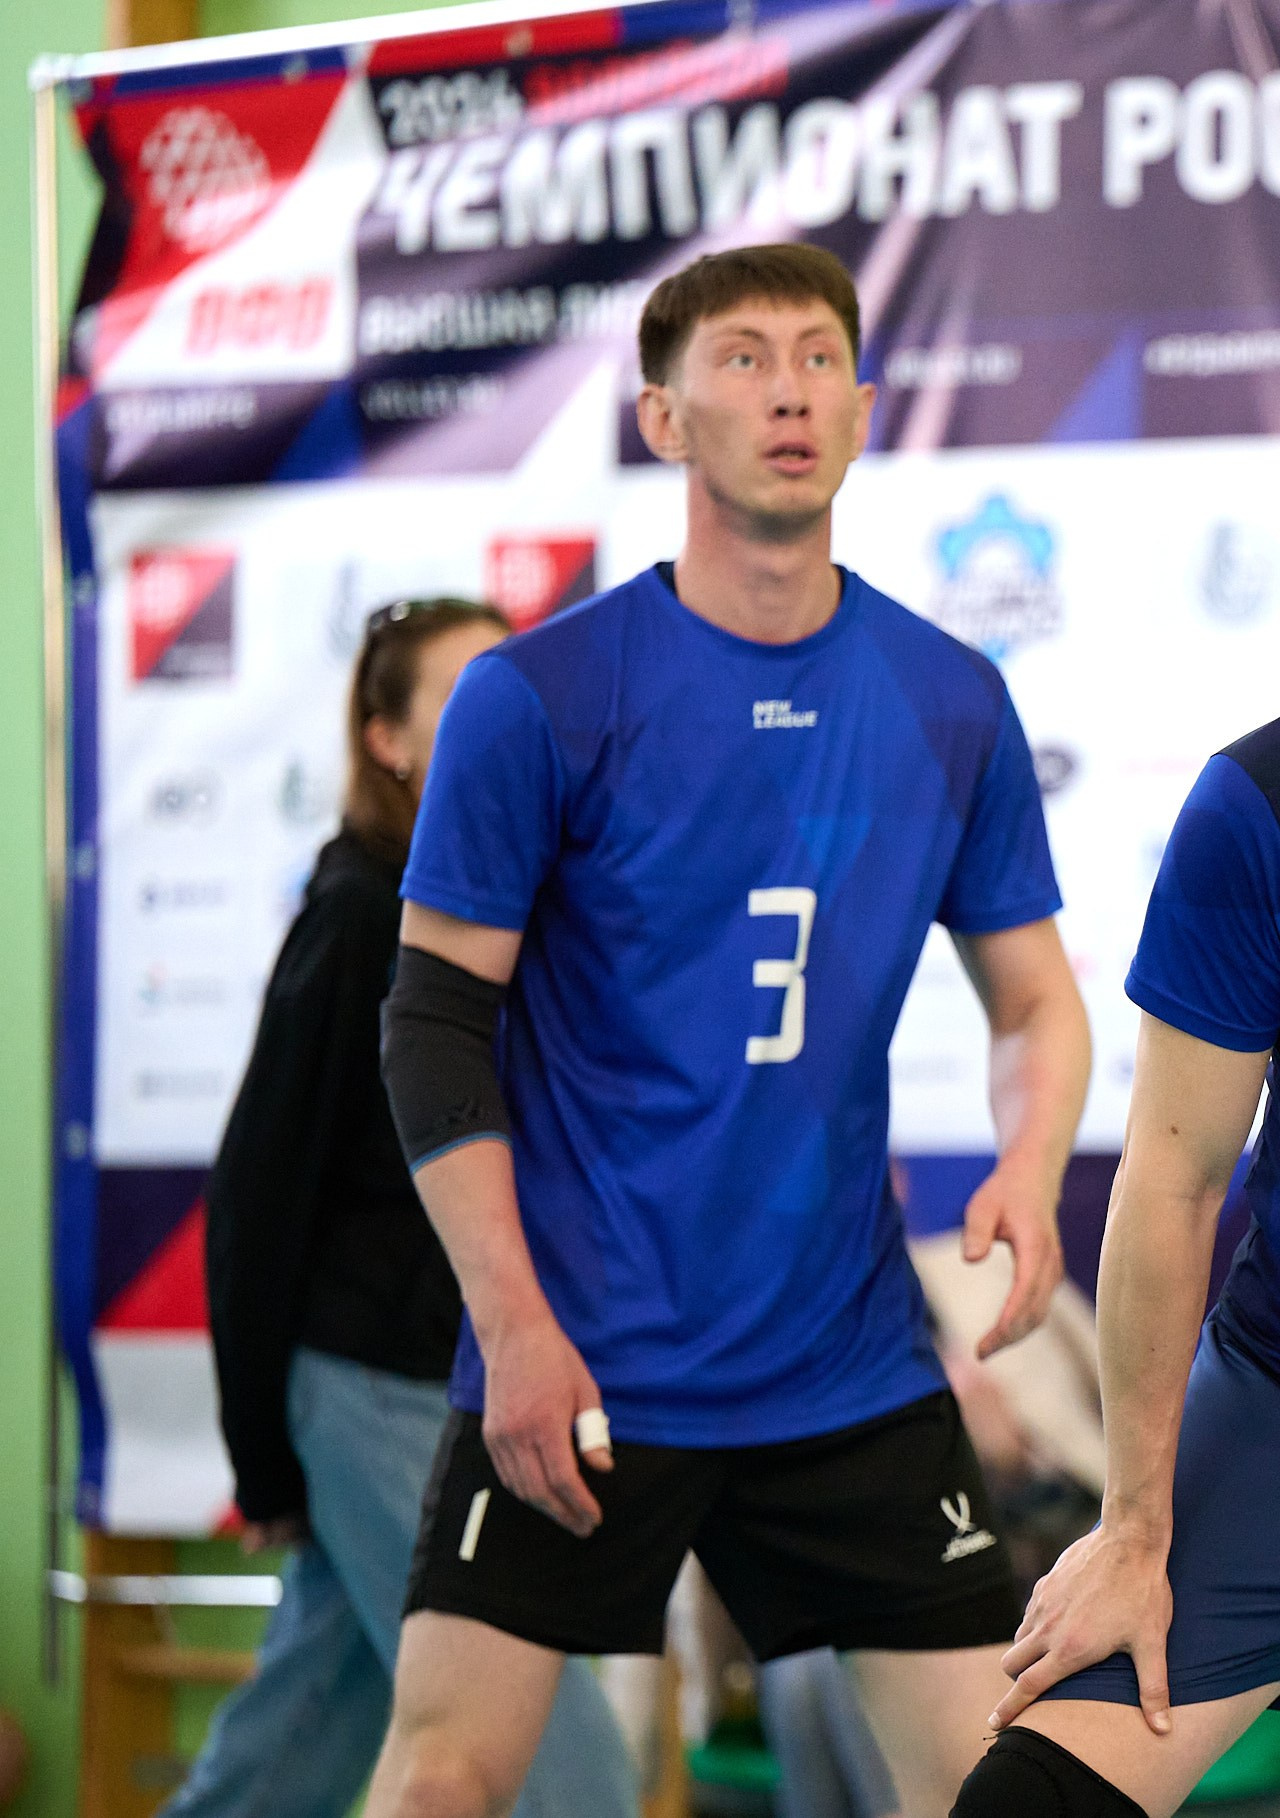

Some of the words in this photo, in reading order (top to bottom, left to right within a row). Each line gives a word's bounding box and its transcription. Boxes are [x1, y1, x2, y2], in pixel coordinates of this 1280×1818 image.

[376, 80, 1084, 257] ЧЕМПИОНАТ
[753, 699, 792, 716] NEW
[745, 886, 817, 1065] 3
